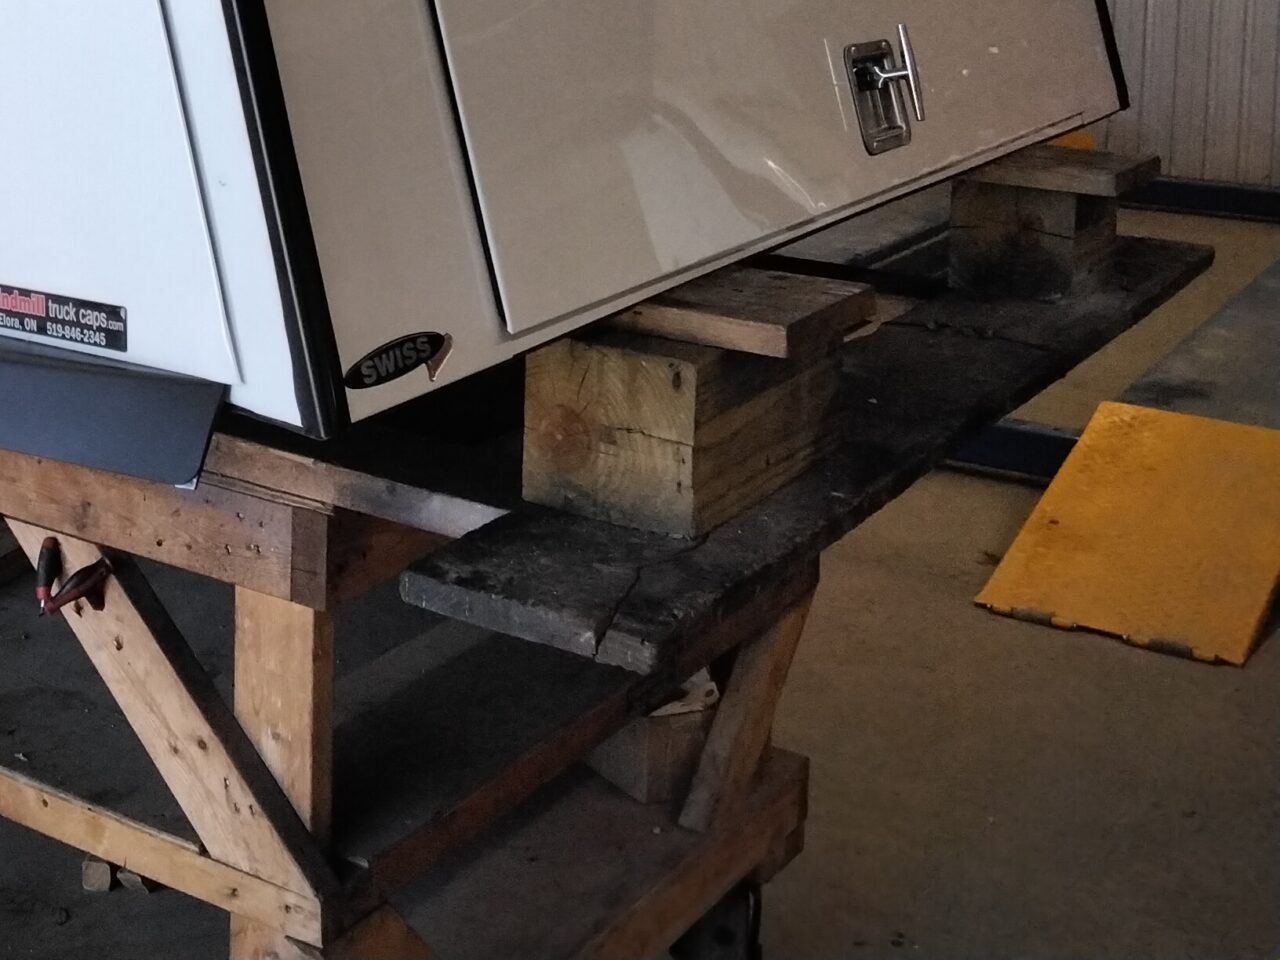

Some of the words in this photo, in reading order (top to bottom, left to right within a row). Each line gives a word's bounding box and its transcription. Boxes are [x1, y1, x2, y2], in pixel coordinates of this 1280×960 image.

[48, 298, 77, 323] truck
[24, 316, 38, 332] ON
[46, 321, 107, 347] 519-846-2345
[360, 335, 432, 385] SWISS
